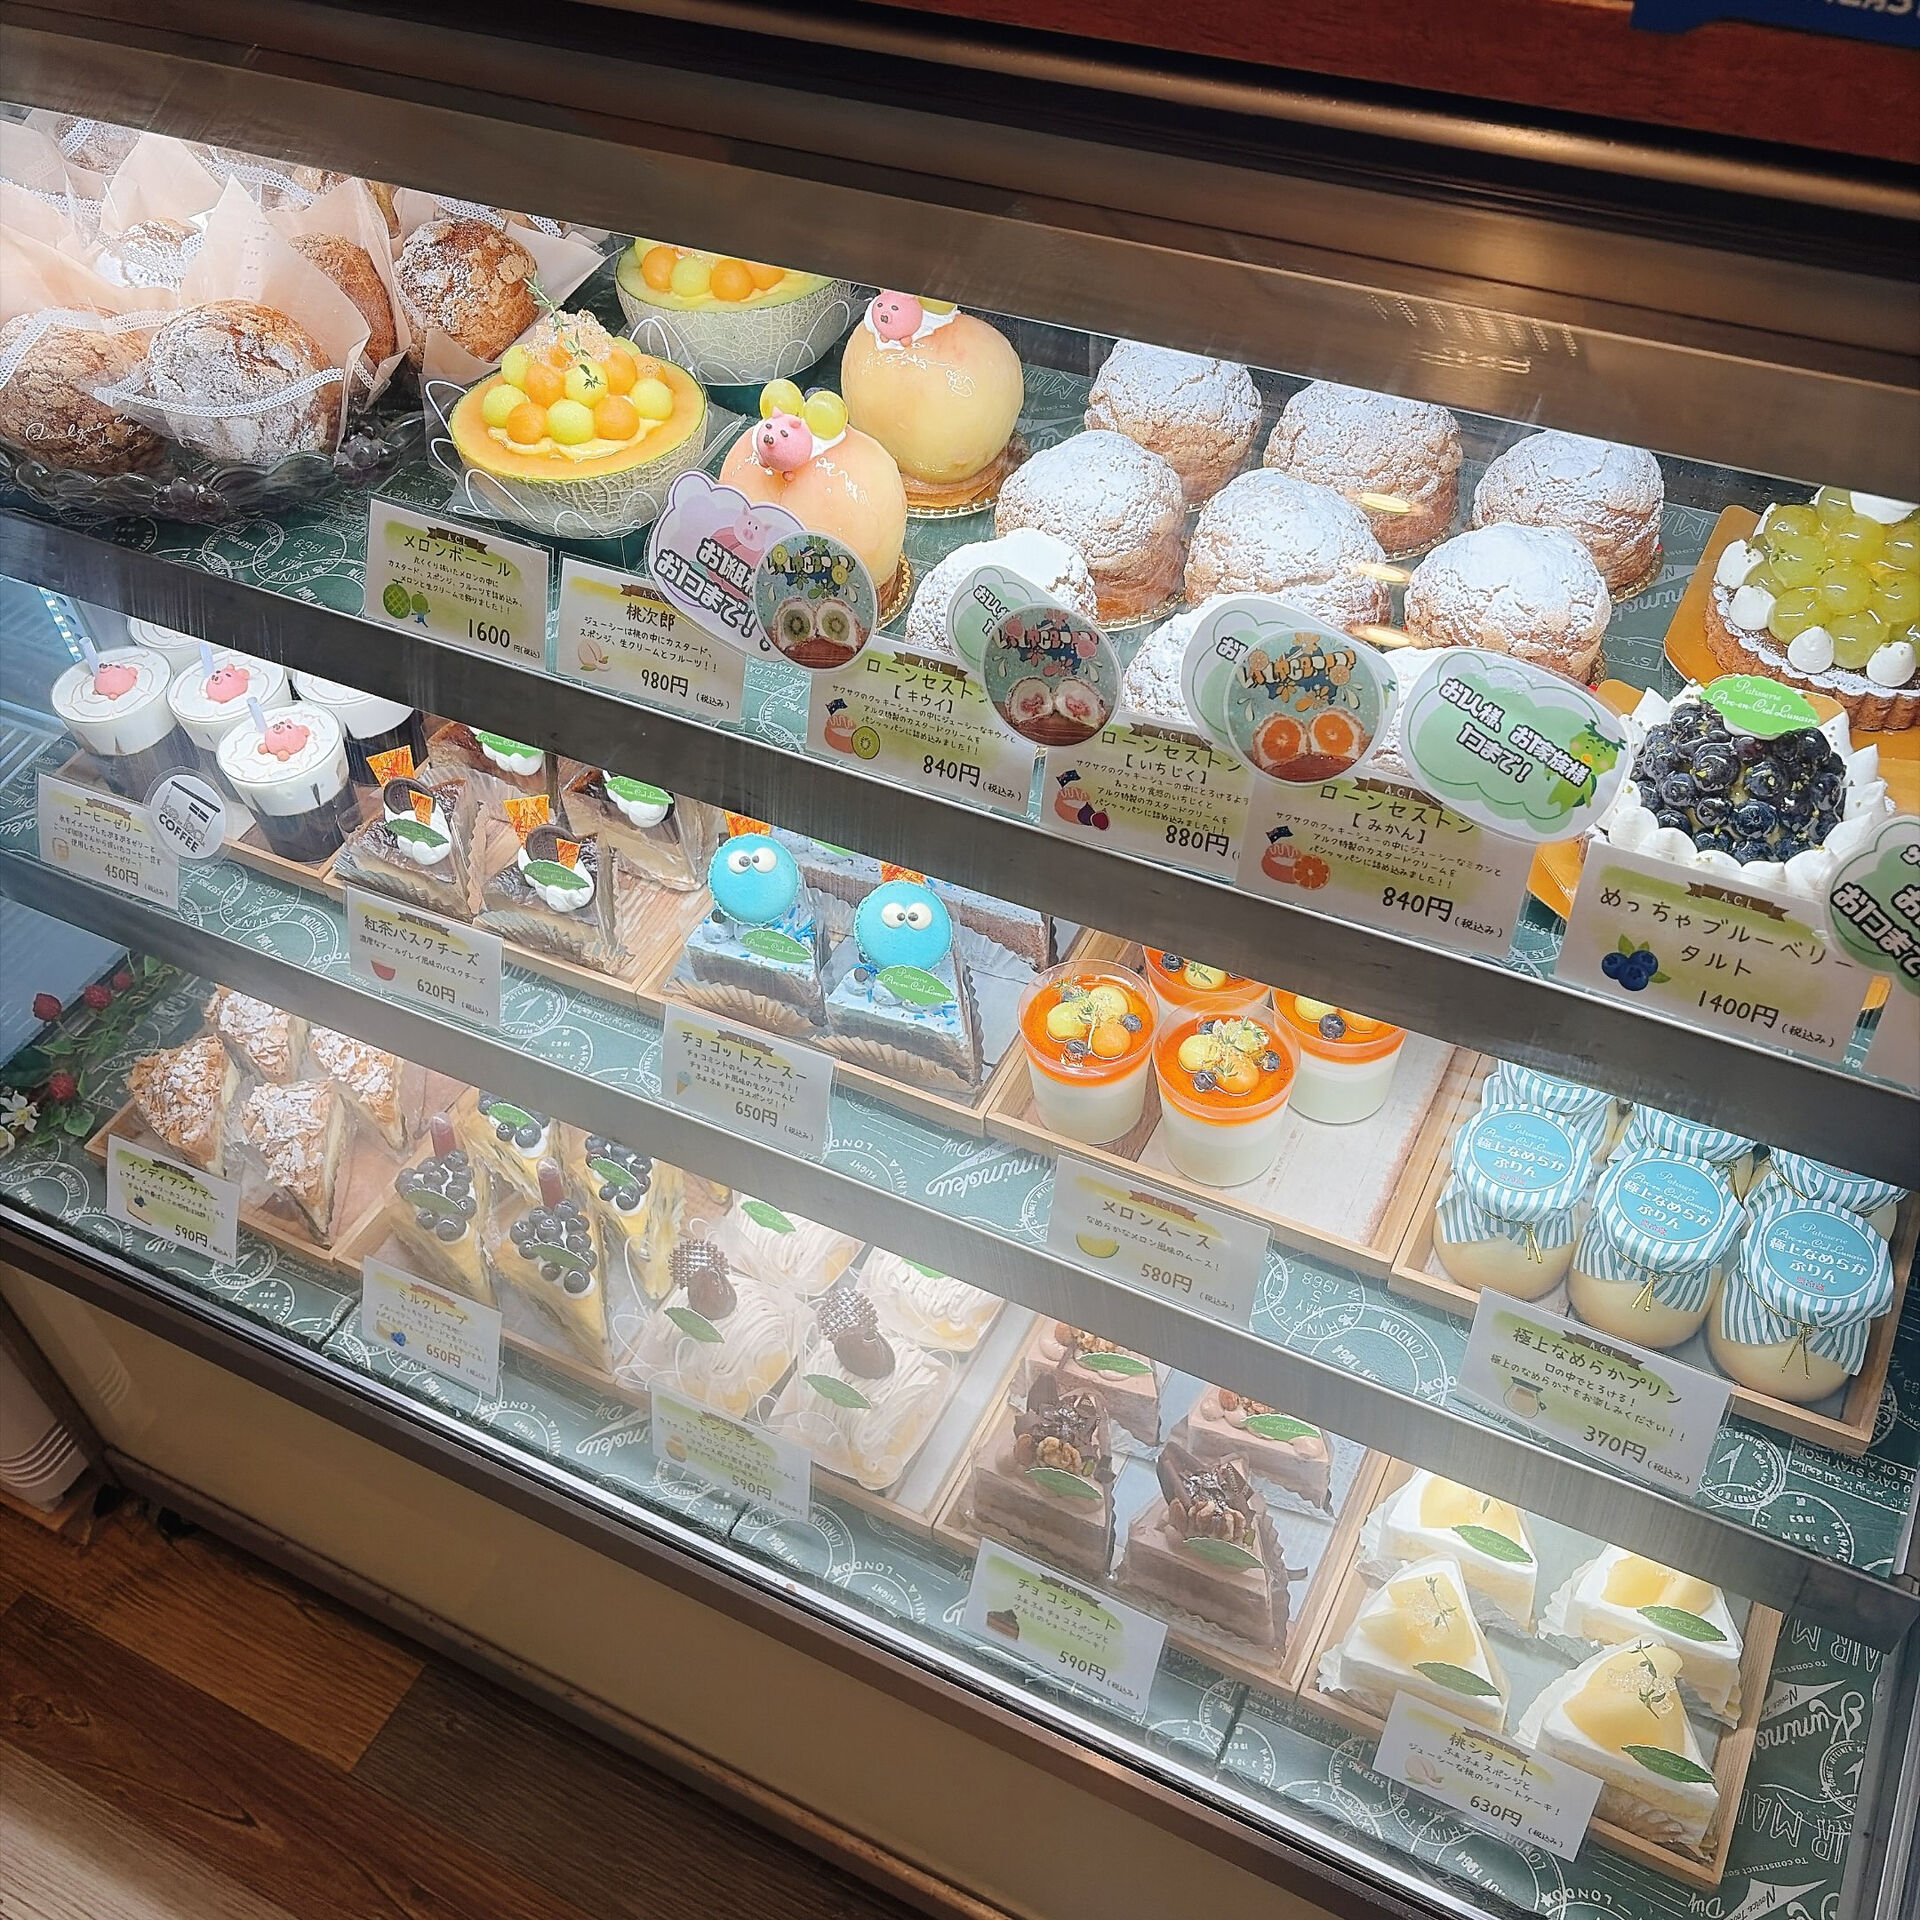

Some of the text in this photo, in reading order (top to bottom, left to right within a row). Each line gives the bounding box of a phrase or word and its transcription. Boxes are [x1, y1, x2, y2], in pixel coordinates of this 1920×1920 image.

[468, 618, 511, 649] 1600
[626, 602, 676, 632] 桃次郎
[641, 669, 689, 697] 980円
[866, 658, 987, 703] ローンセスト
[1102, 731, 1242, 772] ローンセストン
[1125, 754, 1207, 784] 【いちじく】
[923, 755, 980, 788] 840円
[74, 805, 143, 833] コーヒーゼリー
[1320, 785, 1474, 834] ローンセストン
[159, 814, 199, 853] COFFEE
[1166, 825, 1230, 856] 880円
[1352, 812, 1425, 844] 【みかん】
[104, 864, 139, 886] 450円
[1382, 886, 1503, 938] 840円 (税込み)
[1600, 886, 1855, 968] めっちゃブルーベリー
[365, 915, 480, 966] 紅茶バスクチーズ
[1681, 944, 1752, 977] タルト
[417, 979, 455, 1004] 620円
[1699, 990, 1835, 1047] 1400円 (税込み)
[682, 1031, 807, 1080] チョコットスースー
[735, 1101, 778, 1128] 650円
[1477, 1136, 1565, 1171] 極上なめらか
[1623, 1180, 1711, 1227] 極上なめらか
[175, 1224, 208, 1247] 590円
[1102, 1200, 1211, 1250] メロンムース
[1770, 1237, 1867, 1276] 極上なめらか
[1140, 1263, 1193, 1294] 580円
[399, 1289, 469, 1325] ミルクレープ
[426, 1344, 461, 1369] 650円
[1513, 1327, 1683, 1405] 極上なめらかプリン
[1544, 1363, 1636, 1407] 口の中でとろける！
[1583, 1425, 1647, 1464] 370円
[731, 1474, 773, 1501] 590円
[1018, 1578, 1116, 1631] チョコショート
[1058, 1650, 1106, 1682] 590円
[1449, 1732, 1533, 1777] 桃ショート
[1469, 1795, 1523, 1828] 630円
